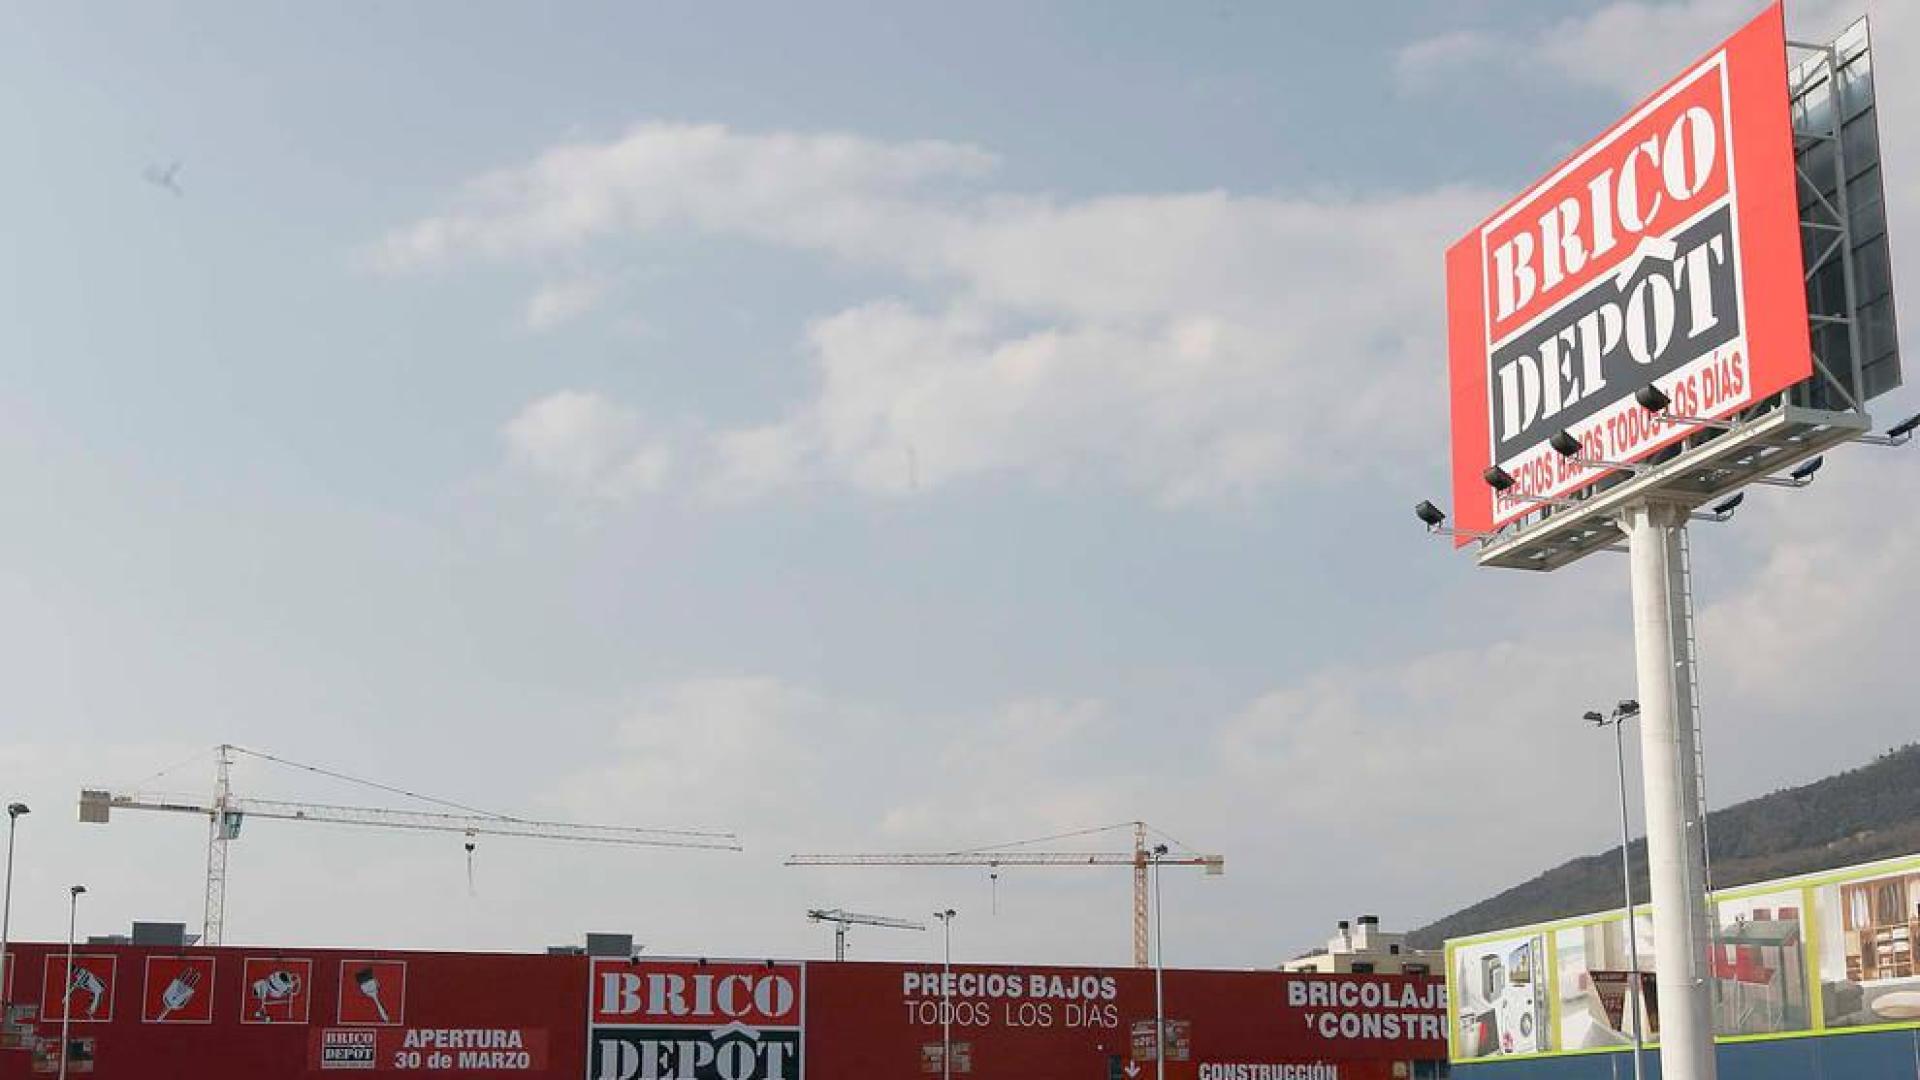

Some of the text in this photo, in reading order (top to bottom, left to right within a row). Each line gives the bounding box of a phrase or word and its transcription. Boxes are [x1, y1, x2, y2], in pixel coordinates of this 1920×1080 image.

[1494, 106, 1716, 323] BRICO
[1499, 233, 1725, 443] DEPÔT
[1703, 350, 1743, 410] DÍAS
[600, 972, 794, 1017] BRICO
[903, 972, 1117, 999] PRECIOS BAJOS
[904, 999, 1118, 1028] TODOS LOS DÍAS
[326, 1032, 373, 1044] BRICO
[404, 1029, 523, 1048] APERTURA
[599, 1020, 794, 1080] DEPÔT
[395, 1051, 530, 1068] 30 de MARZO
